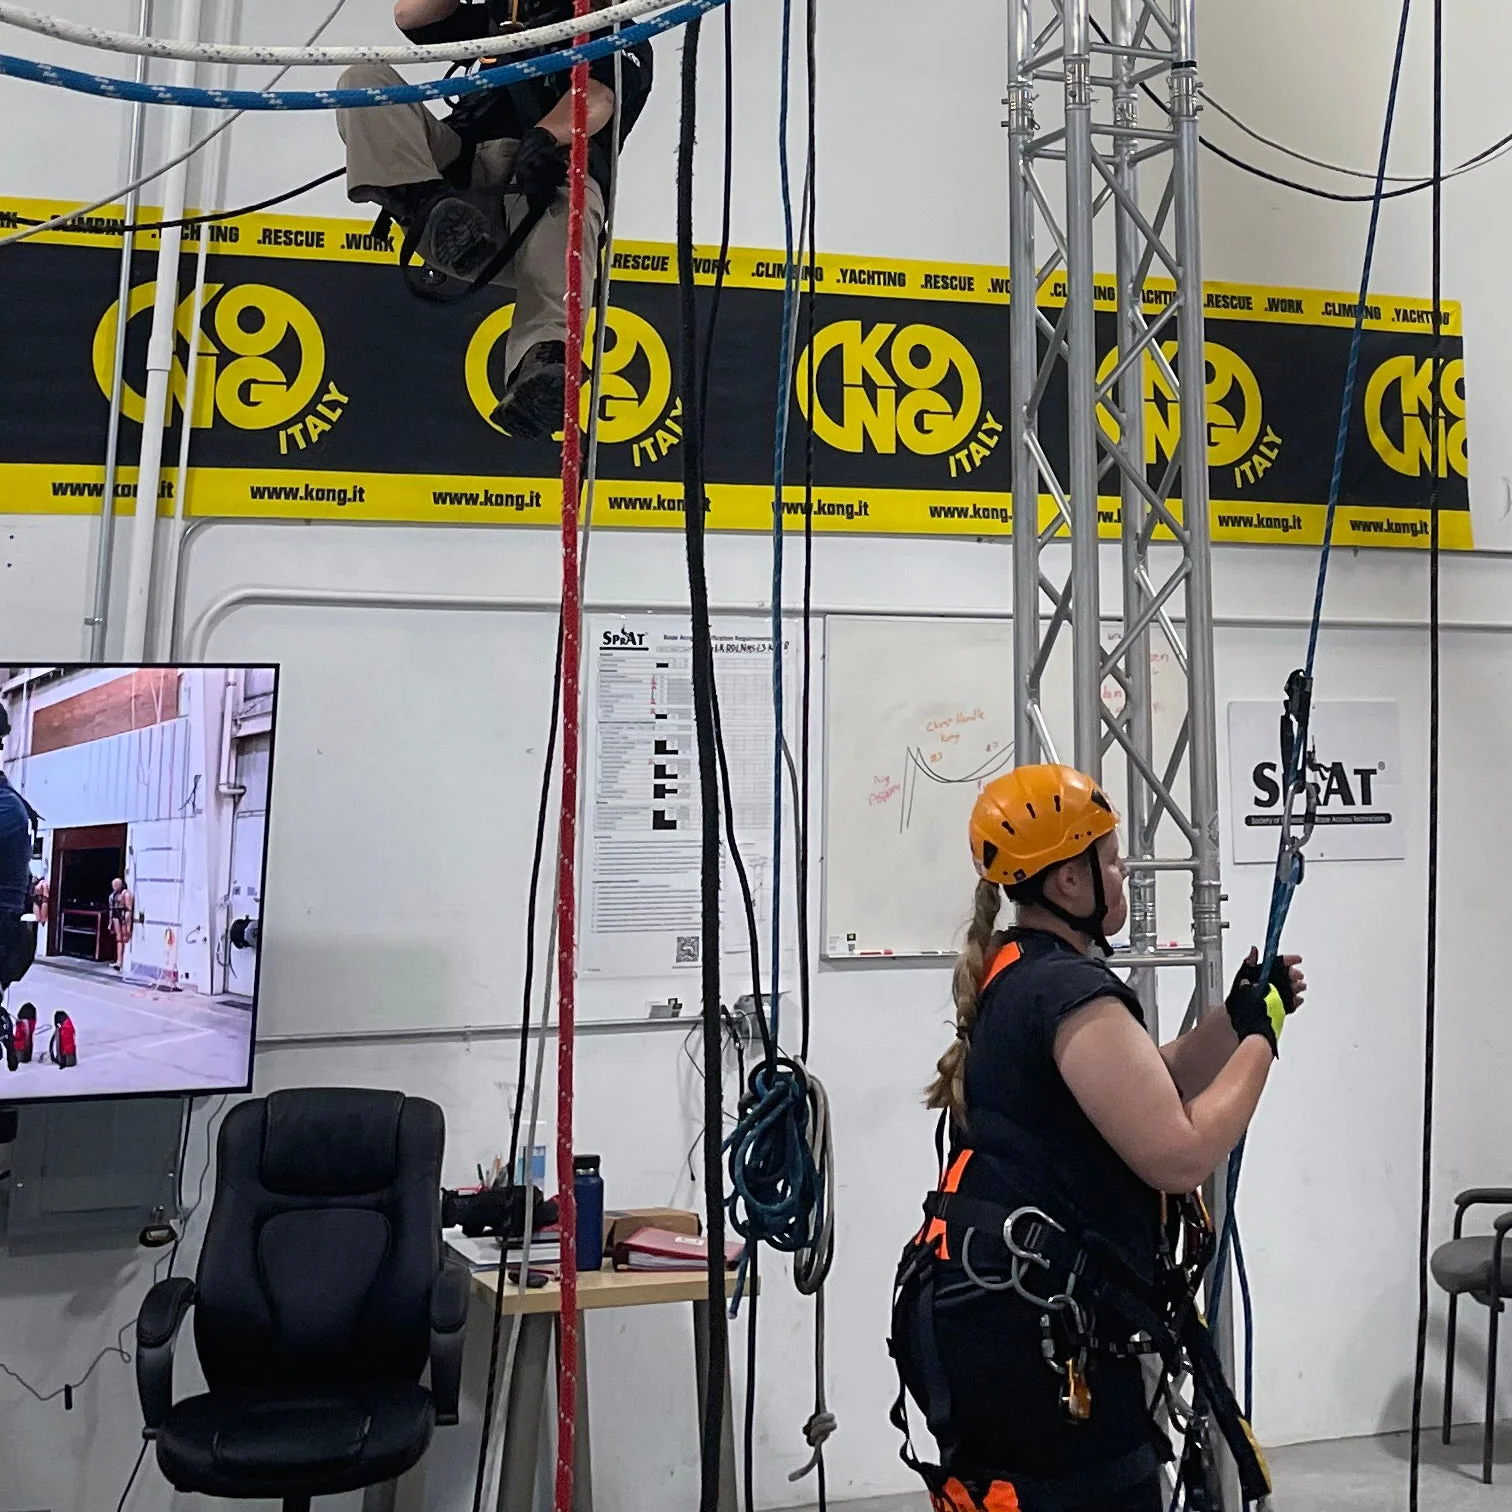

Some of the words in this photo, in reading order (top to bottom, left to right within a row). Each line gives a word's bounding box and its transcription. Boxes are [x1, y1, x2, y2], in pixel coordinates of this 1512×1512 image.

[257, 227, 325, 248] .RESCUE
[836, 268, 906, 287] .YACHTING
[921, 274, 975, 292] .RESCUE
[1204, 293, 1253, 310] .RESCUE
[1264, 297, 1304, 314] .WORK
[279, 381, 349, 455] ITALY
[949, 410, 1003, 478] ITALY
[1234, 425, 1282, 488] ITALY
[250, 484, 365, 506] www.kong.it
[432, 489, 541, 508] www.kong.it
[1217, 512, 1302, 531] www.kong.it
[1350, 518, 1429, 537] www.kong.it
